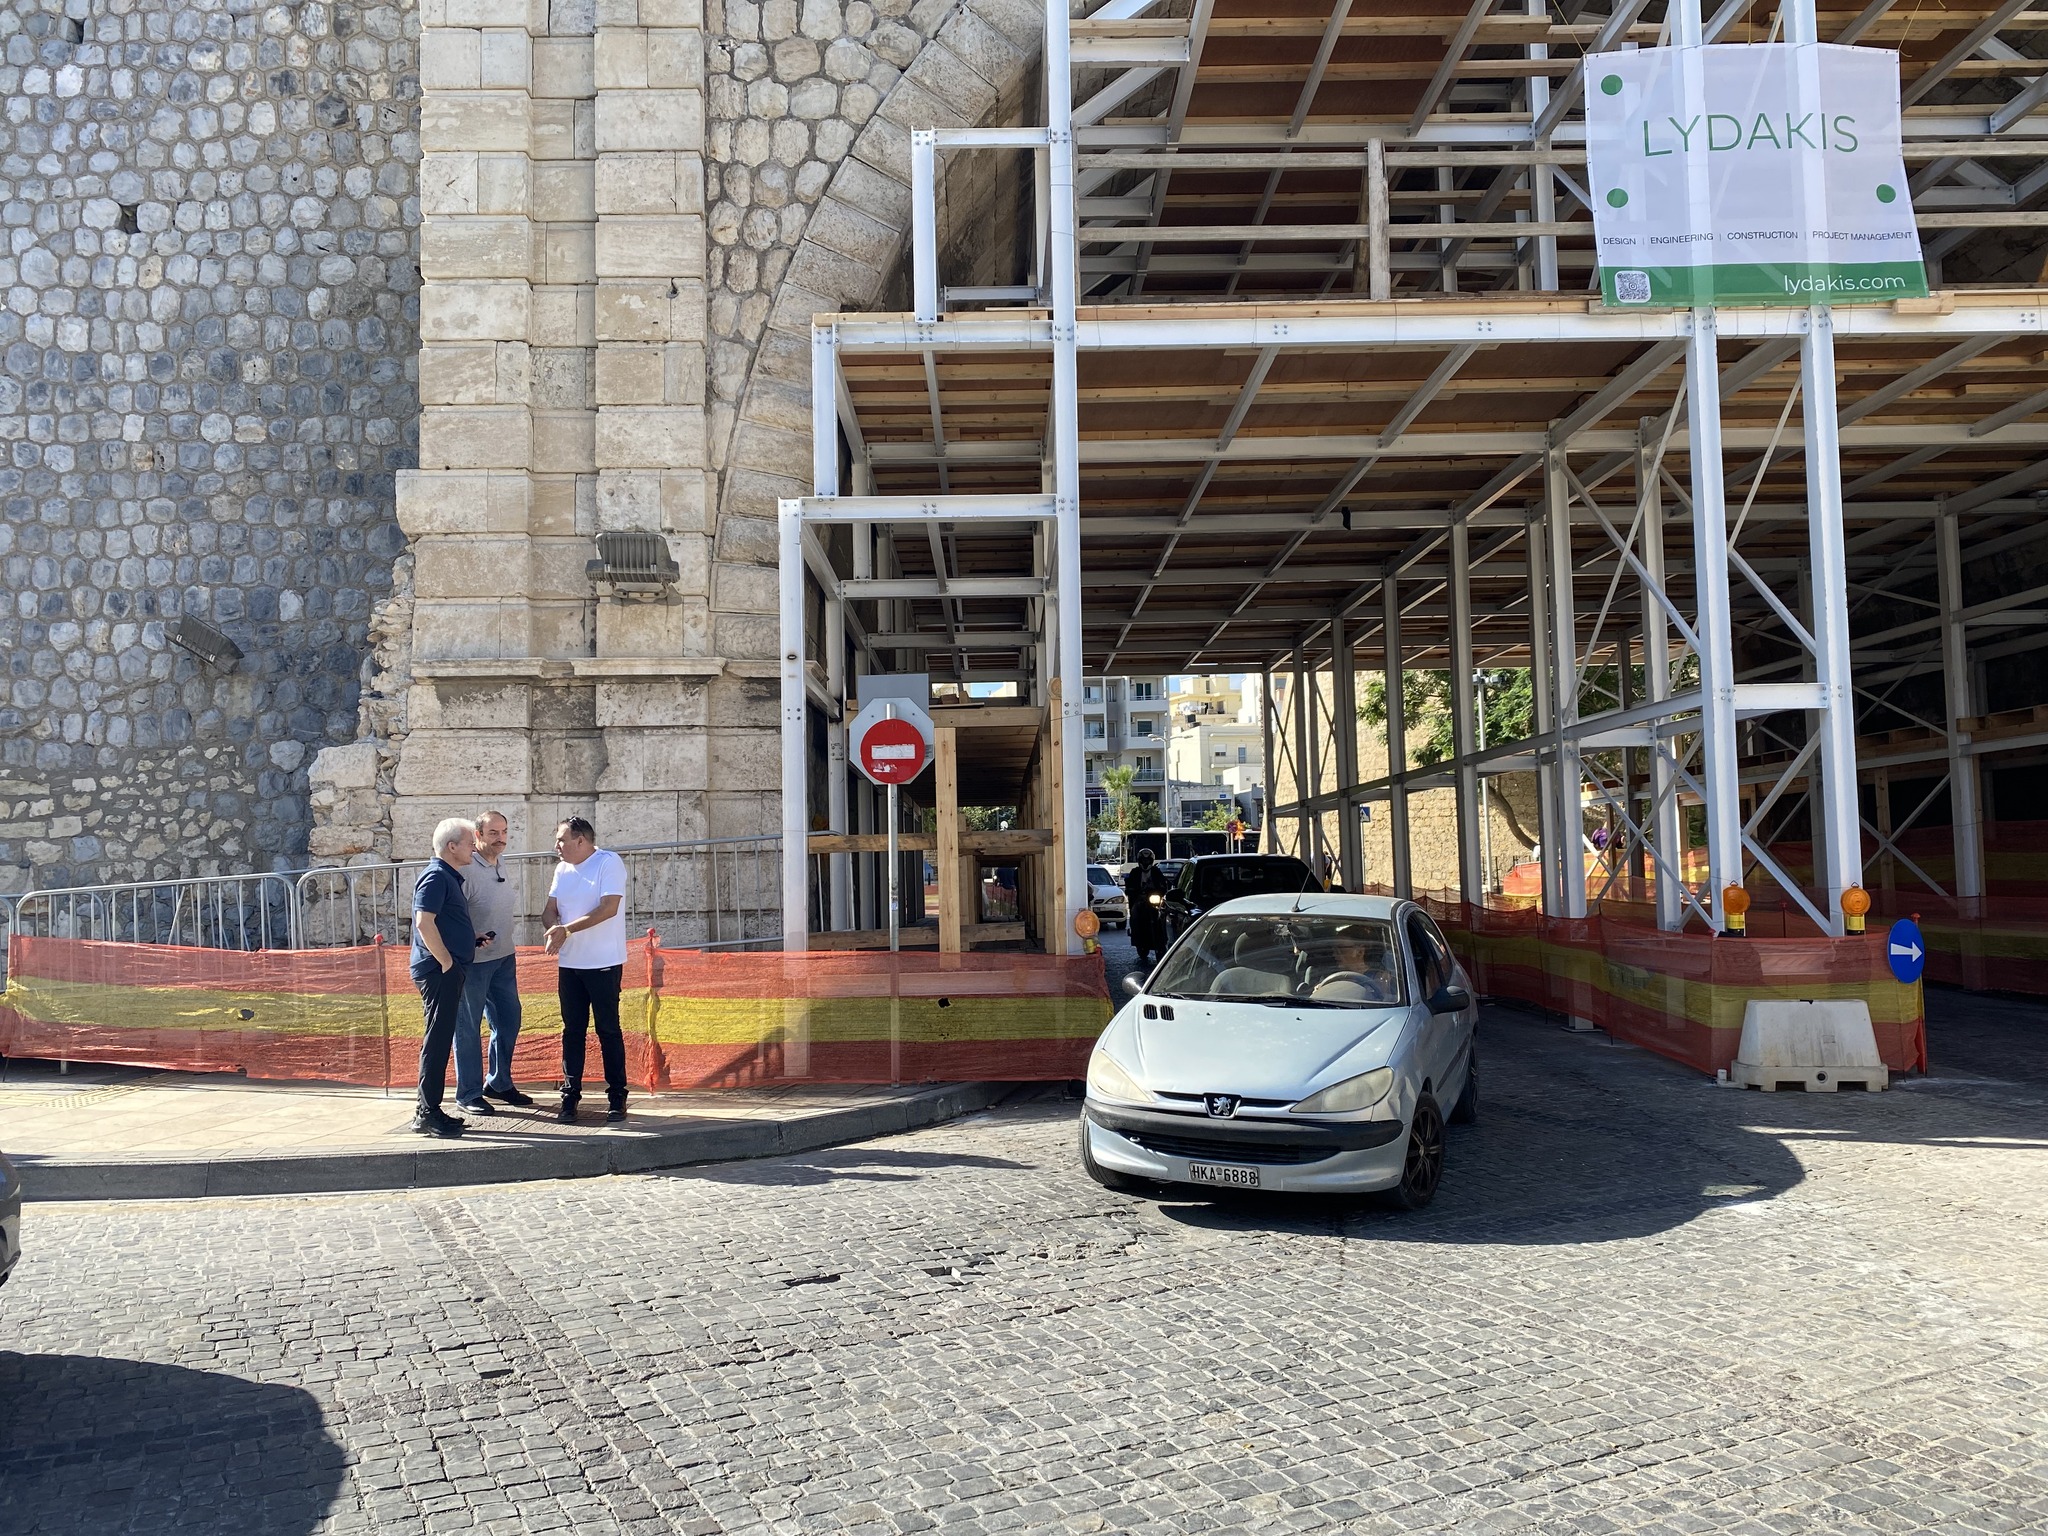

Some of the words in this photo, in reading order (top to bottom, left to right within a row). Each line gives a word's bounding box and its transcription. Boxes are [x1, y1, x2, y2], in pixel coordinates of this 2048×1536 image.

[1643, 112, 1859, 156] LYDAKIS
[1602, 237, 1637, 245] DESIGN
[1650, 232, 1714, 245] ENGINEERING
[1727, 231, 1798, 241] CONSTRUCTION
[1812, 231, 1849, 240] PROJECT
[1850, 231, 1912, 241] MANAGEMENT
[1784, 274, 1906, 296] lydakis.com
